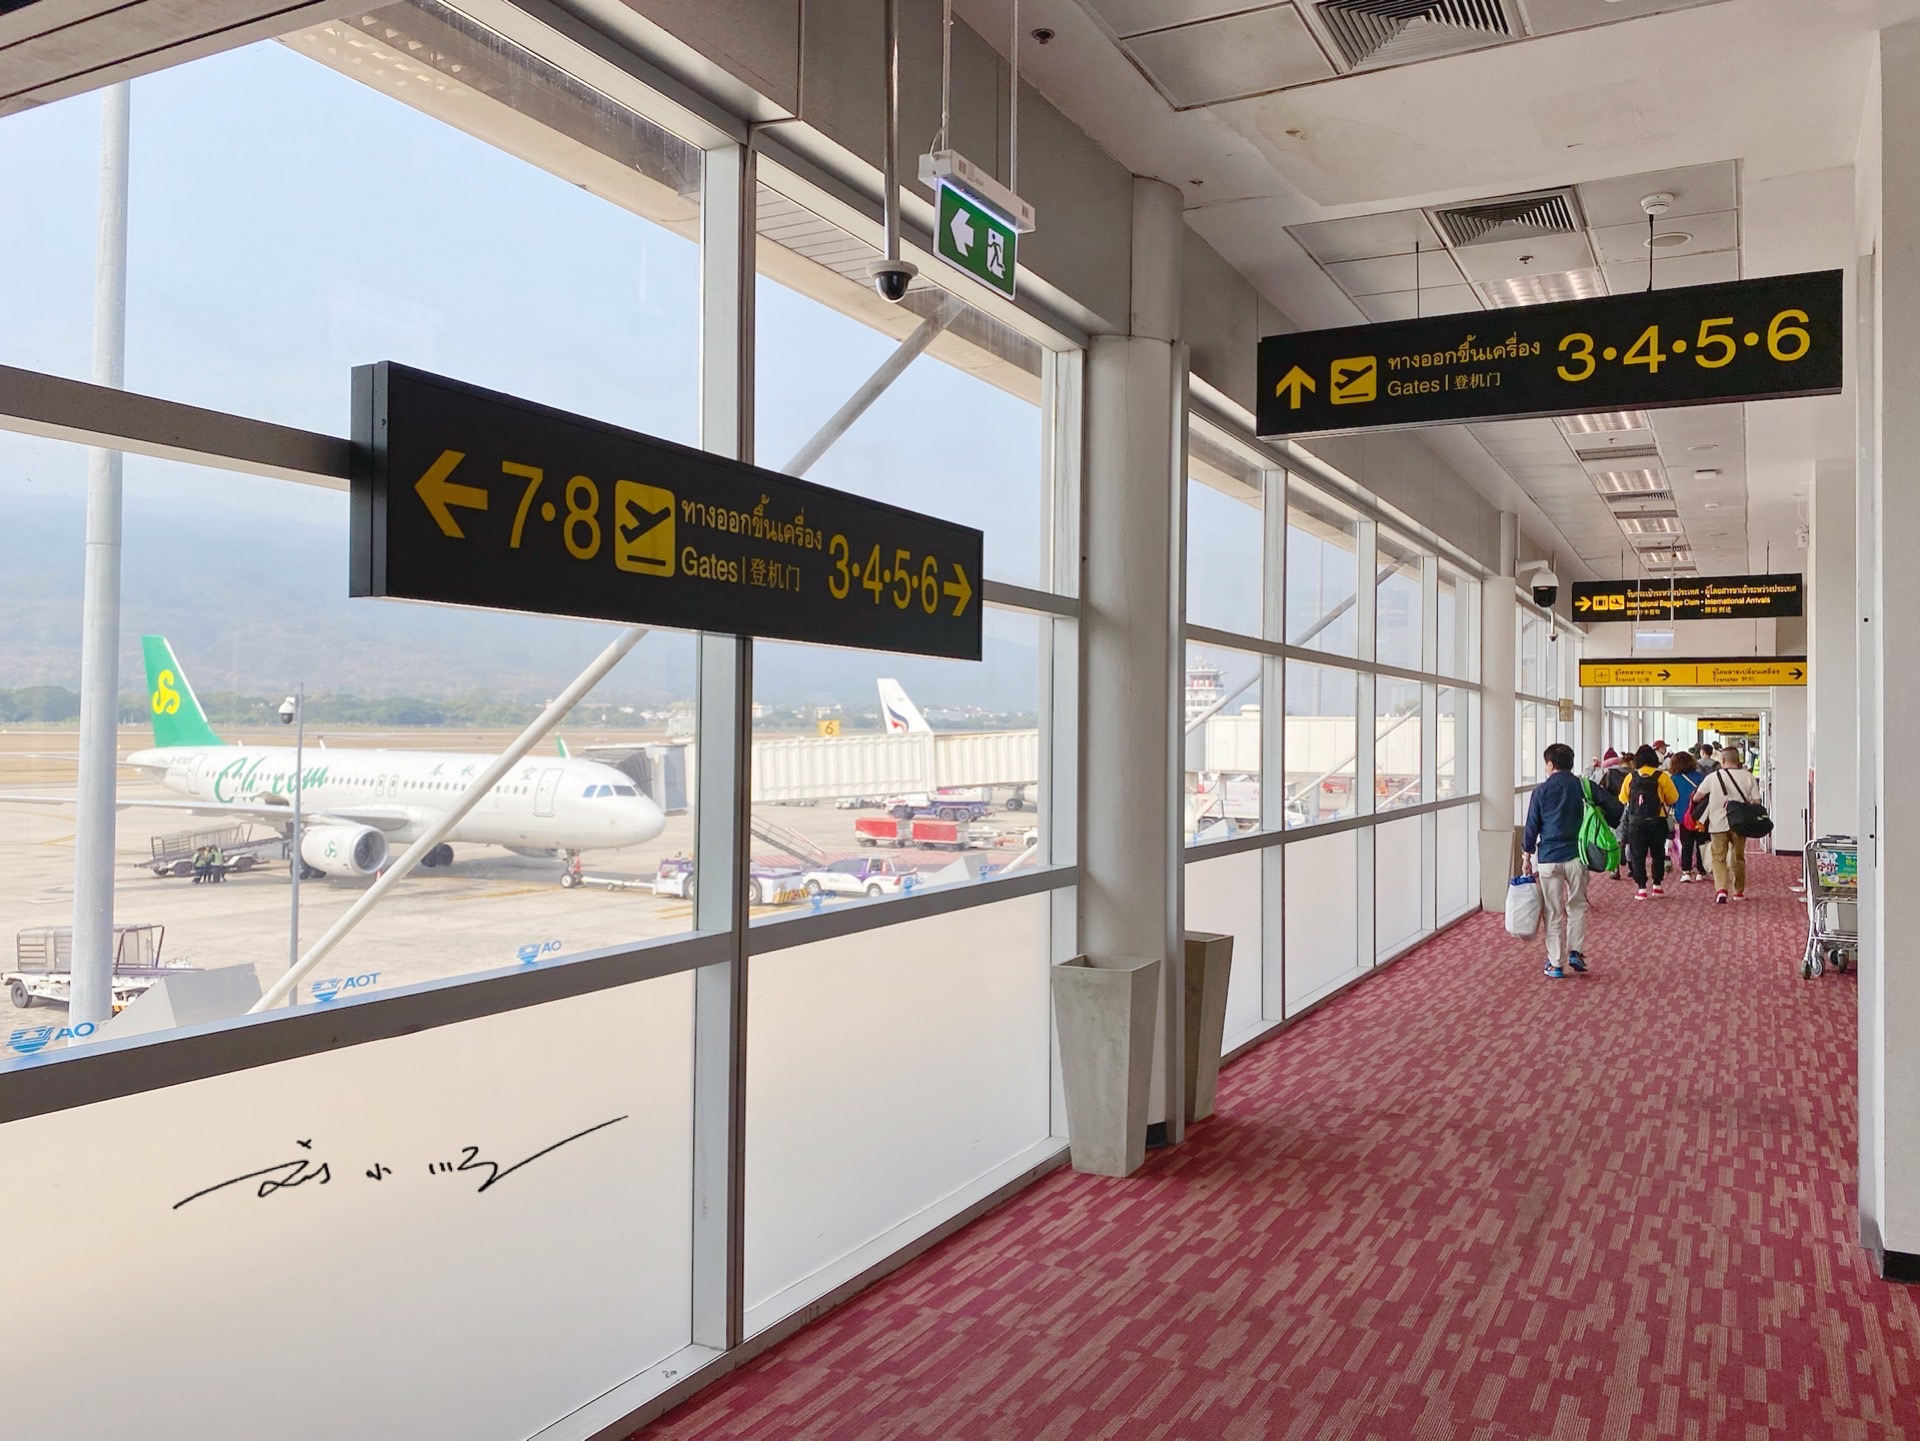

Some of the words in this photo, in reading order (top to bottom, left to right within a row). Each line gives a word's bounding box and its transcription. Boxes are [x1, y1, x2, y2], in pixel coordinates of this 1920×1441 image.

[1387, 331, 1541, 370] ทางออกขึ้นเครื่อง
[1387, 379, 1440, 397] Gates
[1454, 372, 1501, 390] 登机门
[681, 493, 823, 550] ทางออกขึ้นเครื่อง
[681, 546, 738, 583] Gates
[749, 557, 800, 592] 登机门
[1660, 599, 1683, 608] Bagage
[1704, 597, 1745, 605] International
[825, 721, 834, 735] 6
[343, 972, 382, 990] AOT
